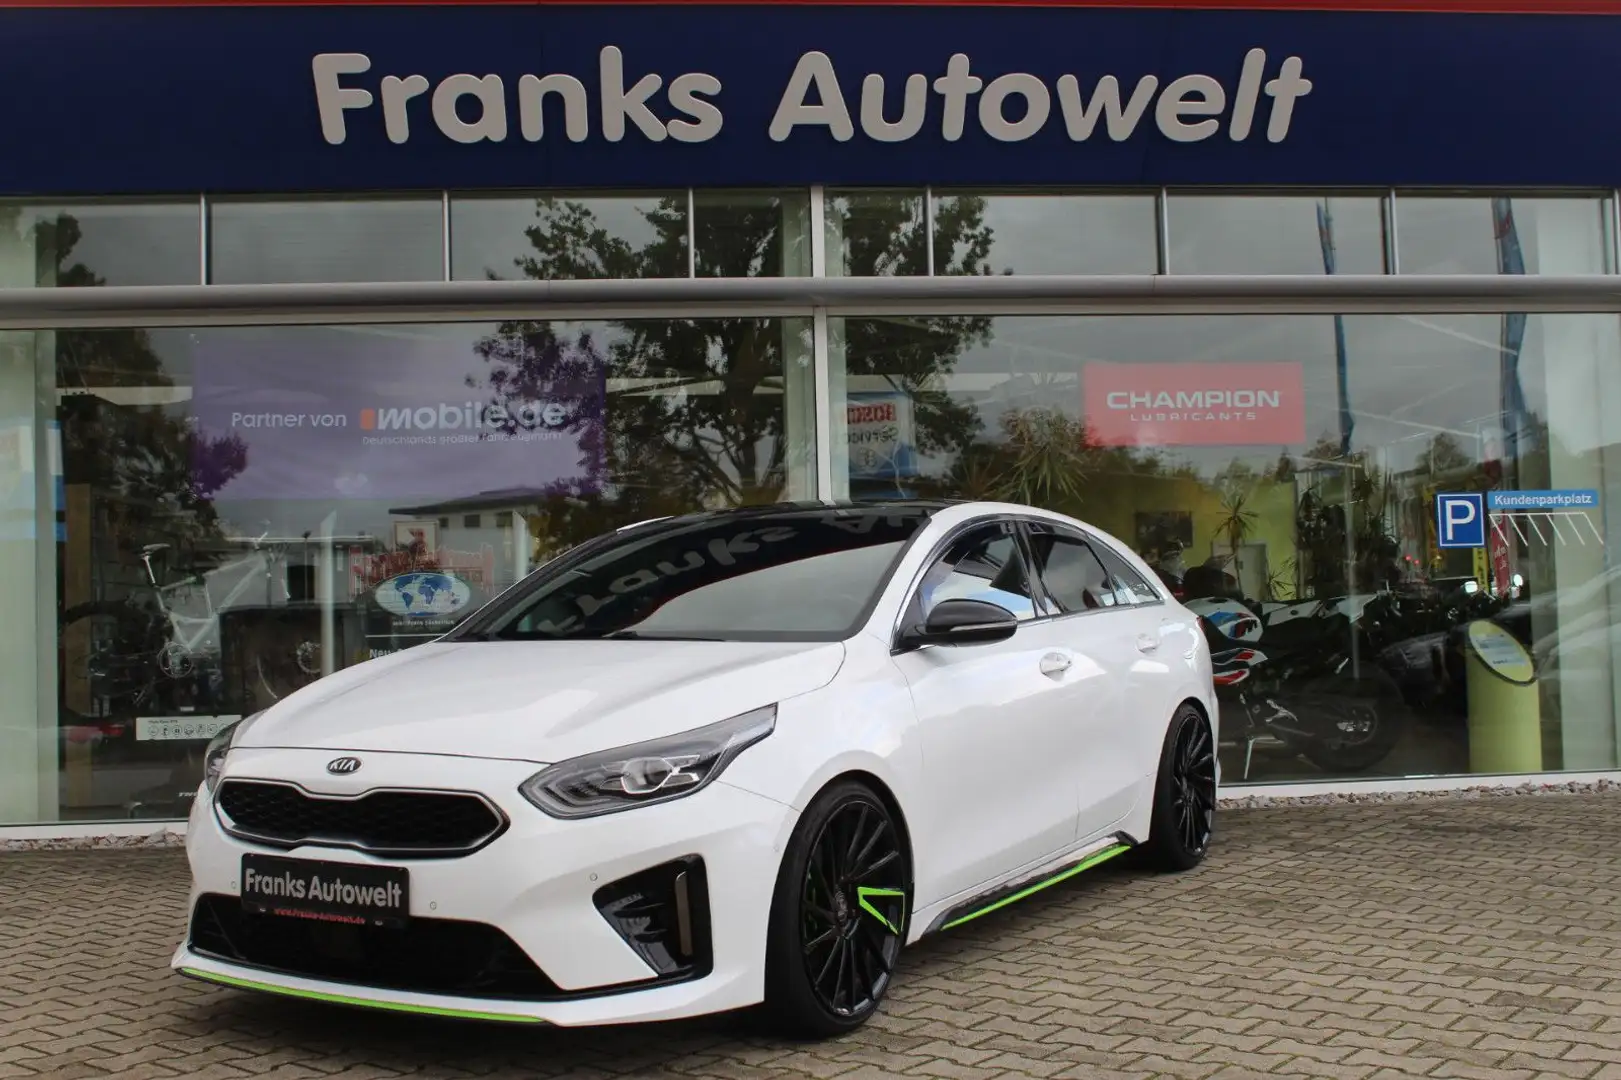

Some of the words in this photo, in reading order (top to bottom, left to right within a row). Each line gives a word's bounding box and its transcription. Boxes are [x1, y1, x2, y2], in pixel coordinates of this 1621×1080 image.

[312, 45, 724, 144] Franks
[768, 47, 1314, 144] Autowelt
[1106, 390, 1281, 410] CHAMPION
[231, 411, 307, 429] Partner
[309, 413, 347, 428] von
[377, 400, 567, 430] mobile.de
[1130, 411, 1257, 422] LUBRICANTS
[1494, 494, 1593, 507] Kundenparkplatz
[1445, 499, 1476, 541] P
[329, 758, 356, 771] KIA
[245, 868, 306, 899] Franks
[307, 875, 402, 908] Autowelt
